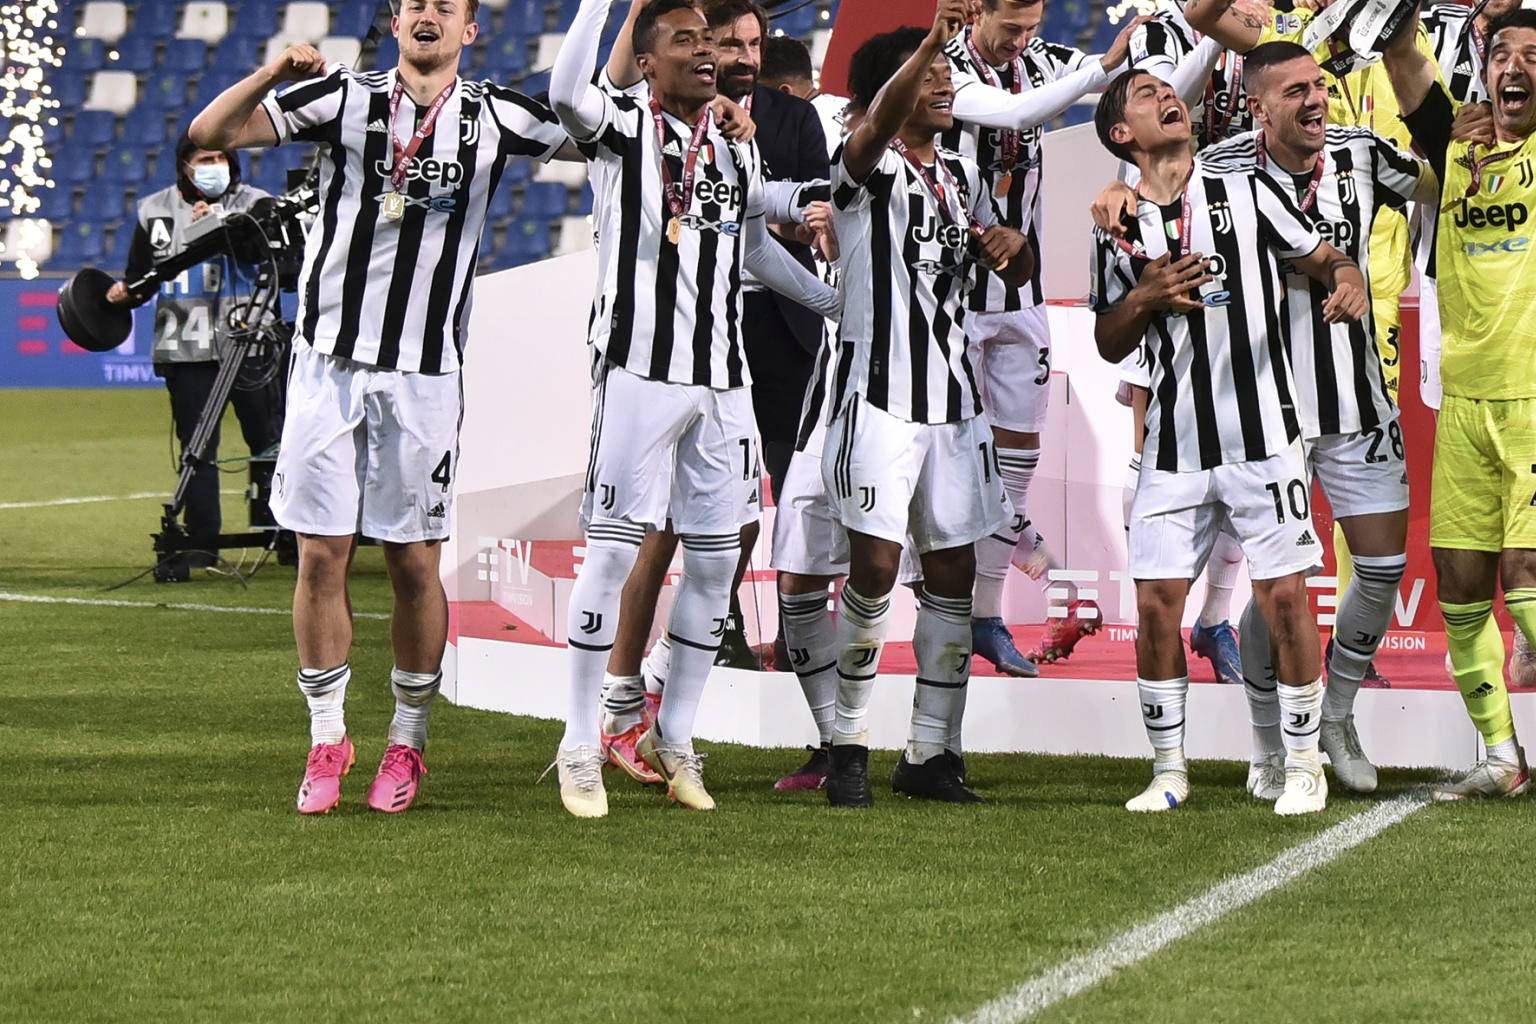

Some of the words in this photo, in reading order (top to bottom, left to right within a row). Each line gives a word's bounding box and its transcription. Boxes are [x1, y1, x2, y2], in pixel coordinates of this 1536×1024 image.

[419, 106, 440, 132] TIMVISION
[435, 96, 446, 108] CUP
[375, 157, 464, 189] Jeep
[1455, 199, 1528, 232] Jeep
[156, 307, 215, 350] 24
[1364, 421, 1403, 464] 28
[430, 450, 452, 493] 4
[1265, 478, 1309, 525] 10
[1379, 637, 1425, 650] VISION
